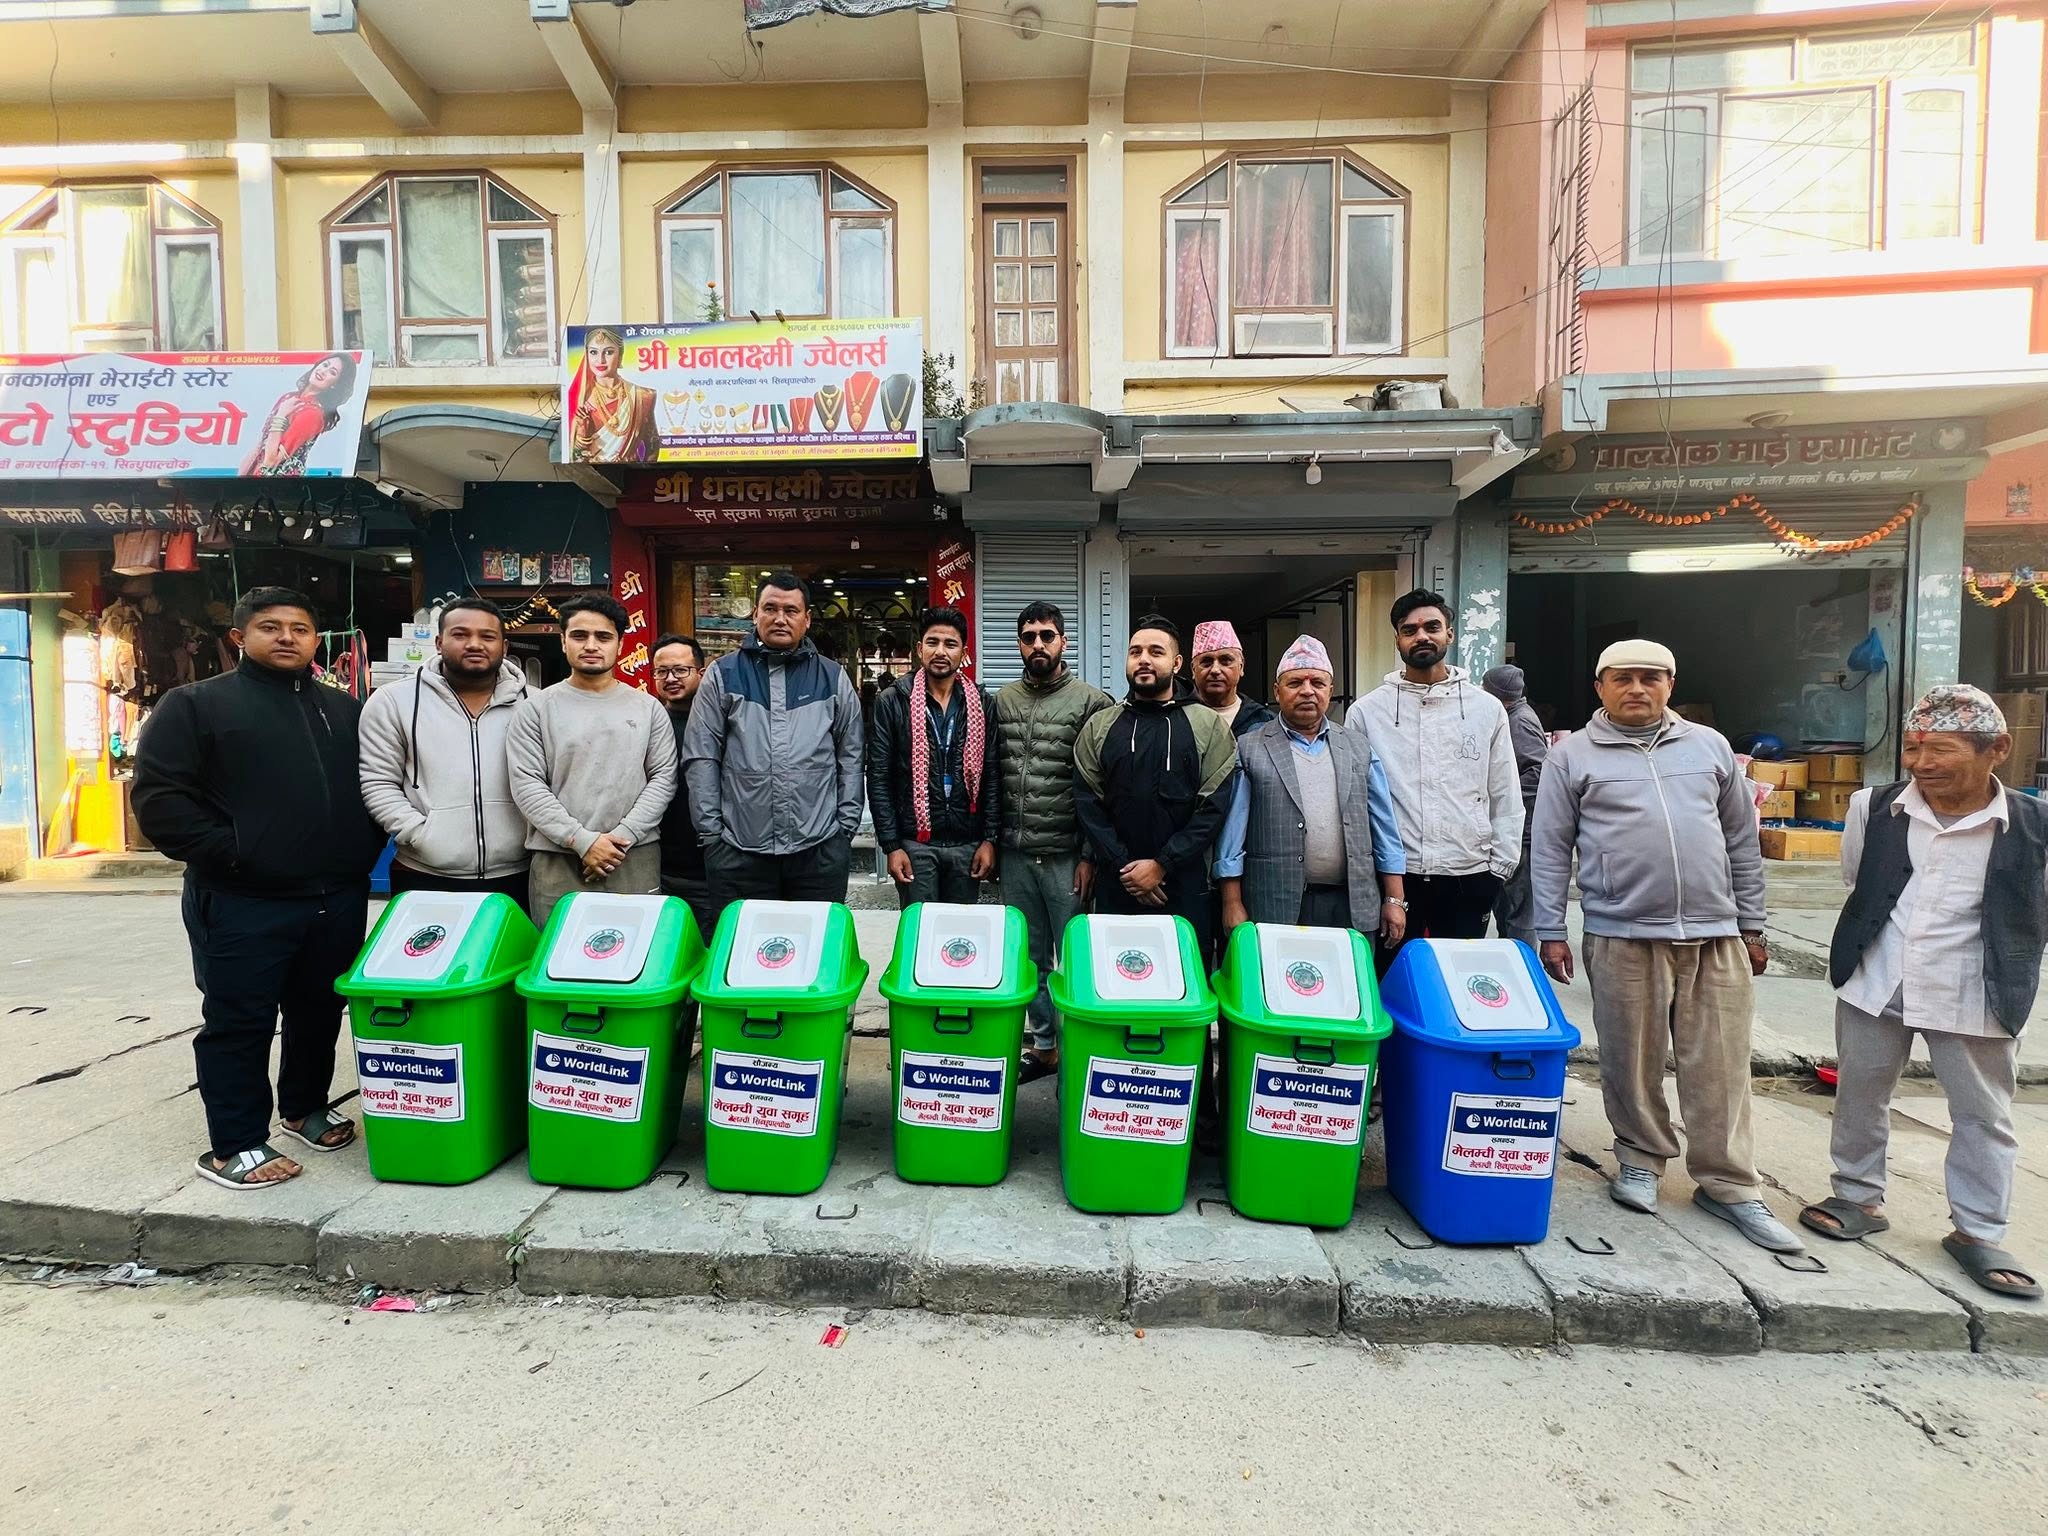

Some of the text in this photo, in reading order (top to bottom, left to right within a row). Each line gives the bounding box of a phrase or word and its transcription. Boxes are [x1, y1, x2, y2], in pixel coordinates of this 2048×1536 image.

[638, 335, 889, 372] श्री धनलक्ष्मी ज्वेलर्स
[182, 367, 233, 388] स्टोर
[87, 393, 121, 407] एण्ड
[67, 400, 248, 457] स्टुडियो
[653, 471, 694, 503] श्री
[702, 469, 824, 502] धनलक्ष्मी
[619, 569, 645, 602] श्री
[943, 579, 966, 606] श्री
[382, 1060, 443, 1077] WorldLink
[564, 1057, 630, 1078] WorldLink
[741, 1073, 806, 1092] WorldLink
[929, 1073, 991, 1088] WorldLink
[1118, 1082, 1182, 1098] WorldLink
[1285, 1080, 1353, 1099] WorldLink
[362, 1086, 454, 1108] मेलम्ची युवा समूह
[535, 1080, 634, 1109] मेलम्ची युवा समूह
[714, 1098, 810, 1123] मेलम्ची युवा समूह
[904, 1097, 995, 1119] मेलम्ची युवा समूह
[1088, 1107, 1184, 1130] मेलम्ची युवा समूह
[1255, 1105, 1356, 1131] मेलम्ची युवा समूह
[1483, 1115, 1548, 1131] WorldLink
[1452, 1144, 1551, 1165] मेलम्ची युवा समूह
